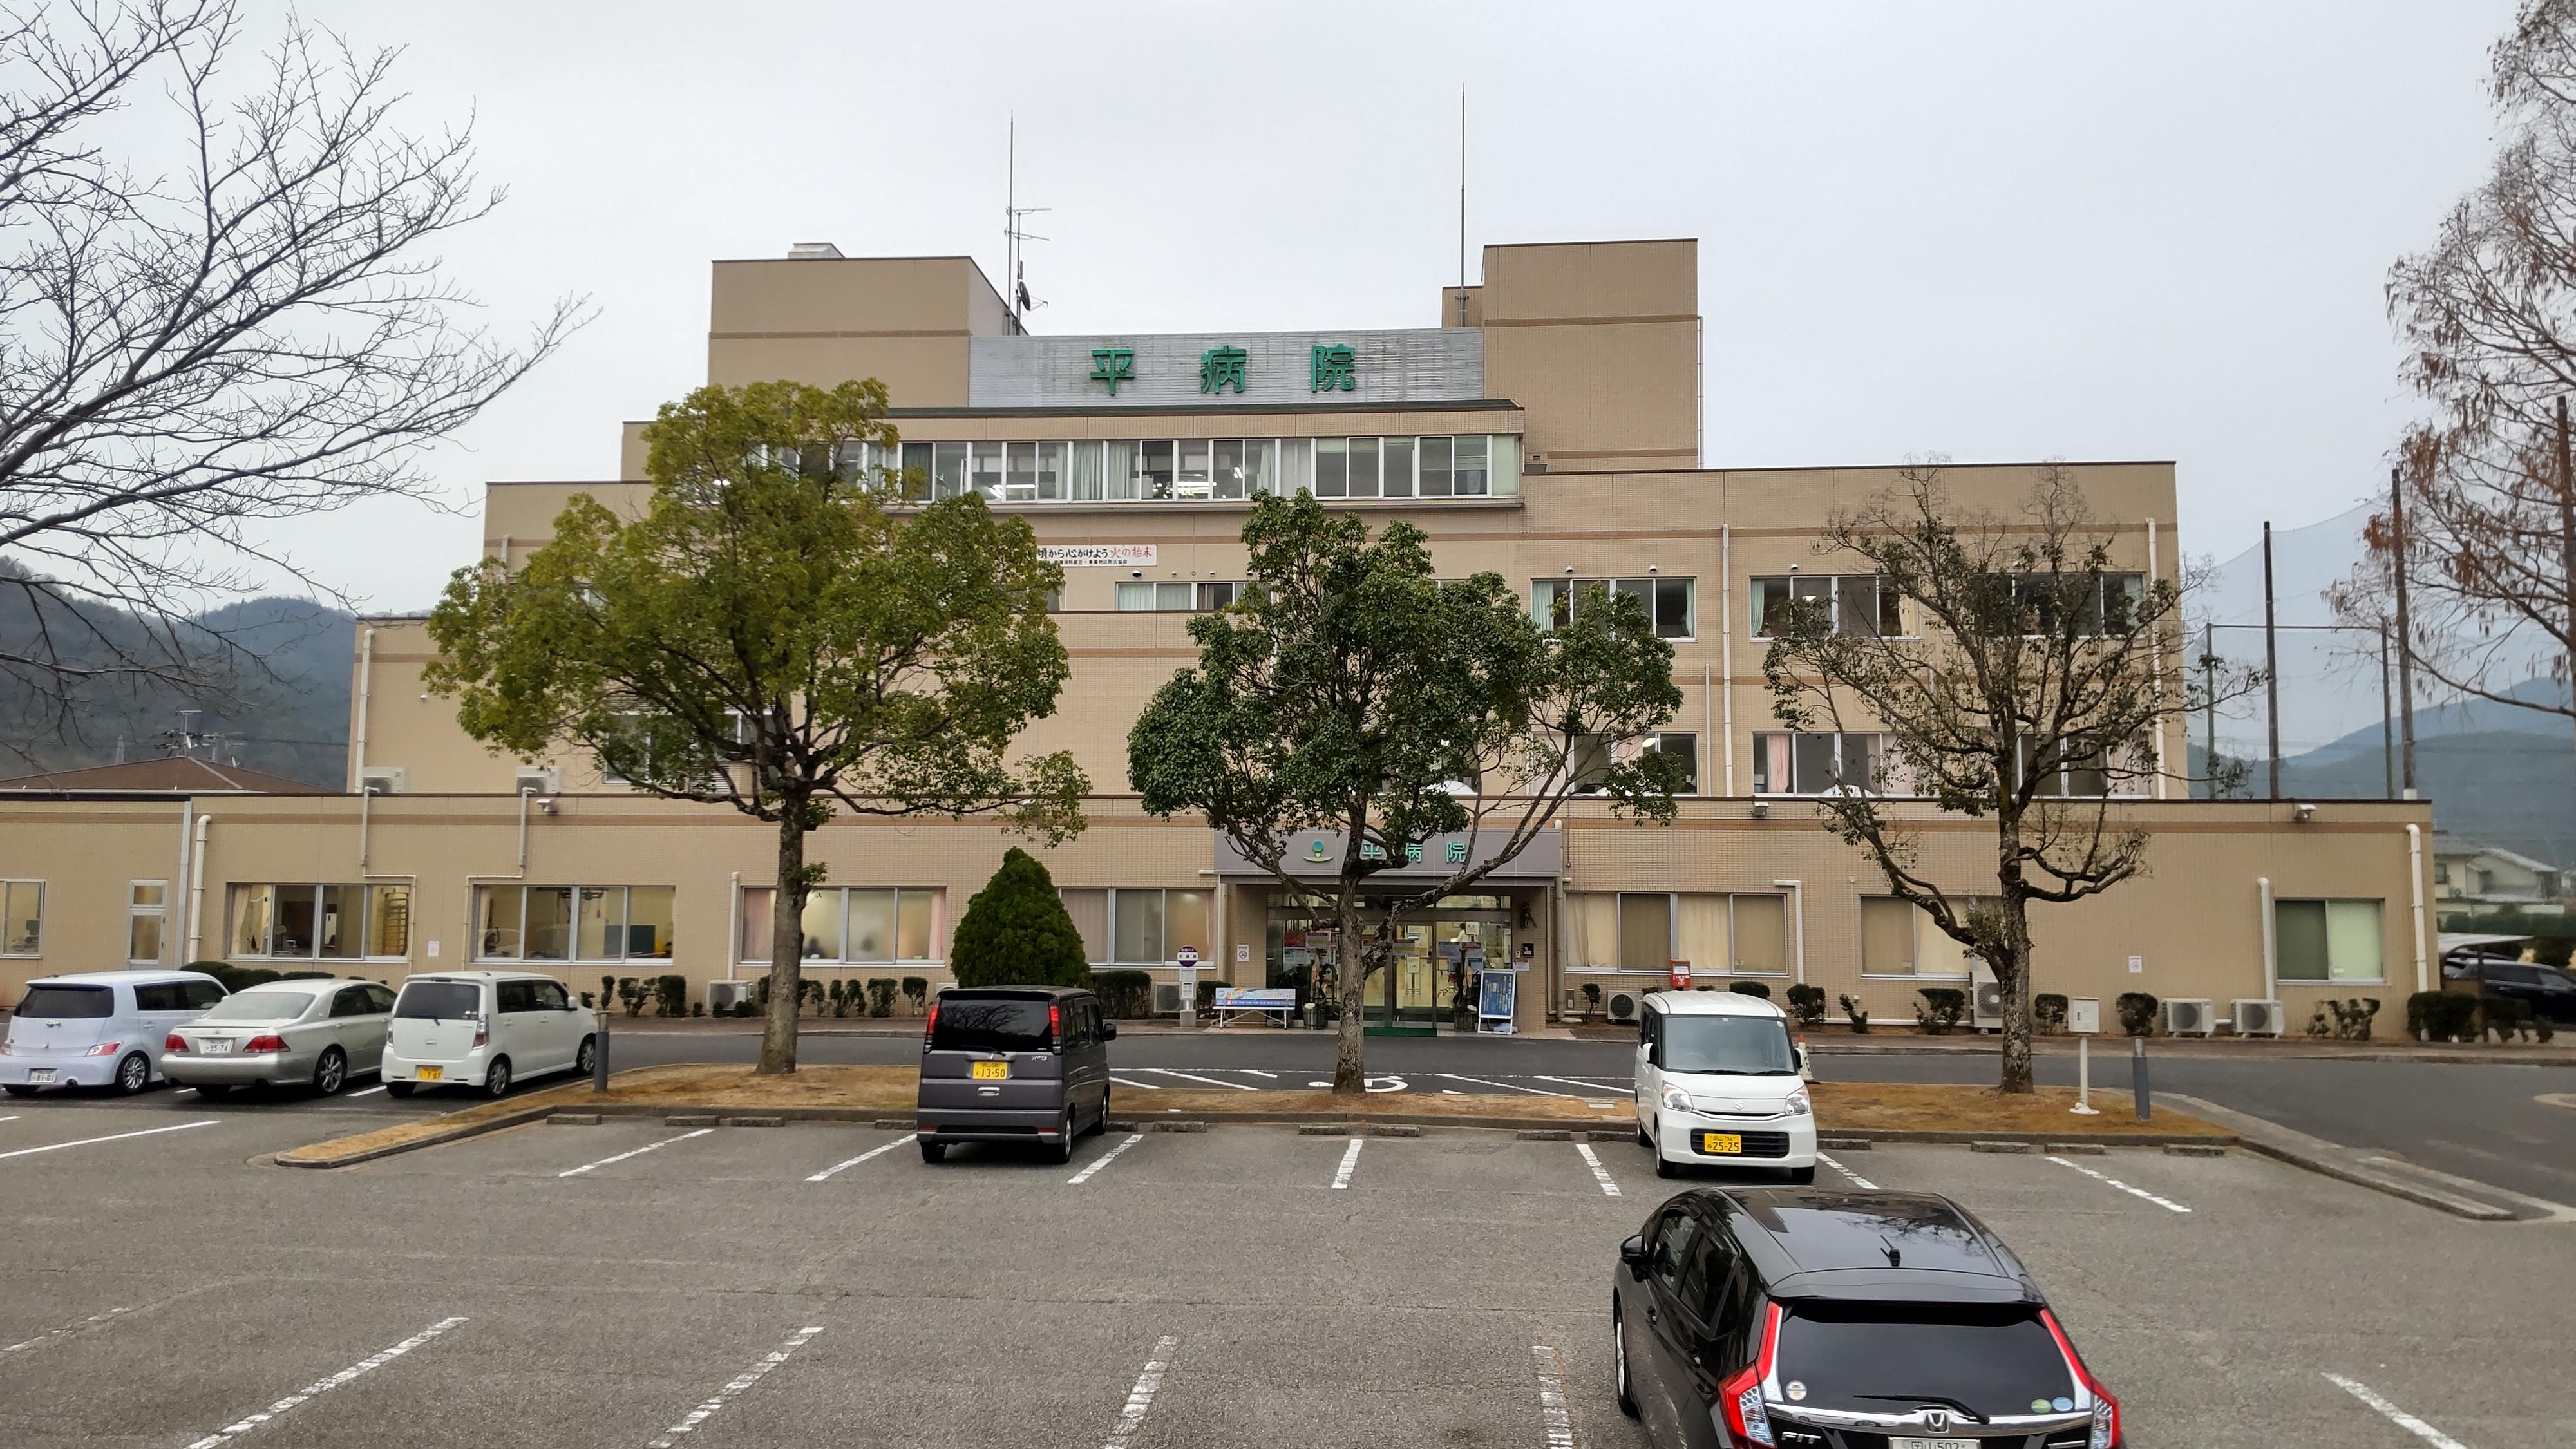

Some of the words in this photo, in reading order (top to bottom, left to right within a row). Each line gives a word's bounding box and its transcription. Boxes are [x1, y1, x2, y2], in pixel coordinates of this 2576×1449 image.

[1090, 343, 1355, 396] 平病院
[981, 1068, 1005, 1078] 13-50
[1713, 1141, 1739, 1151] 25-25
[1781, 1432, 1822, 1444] FIT
